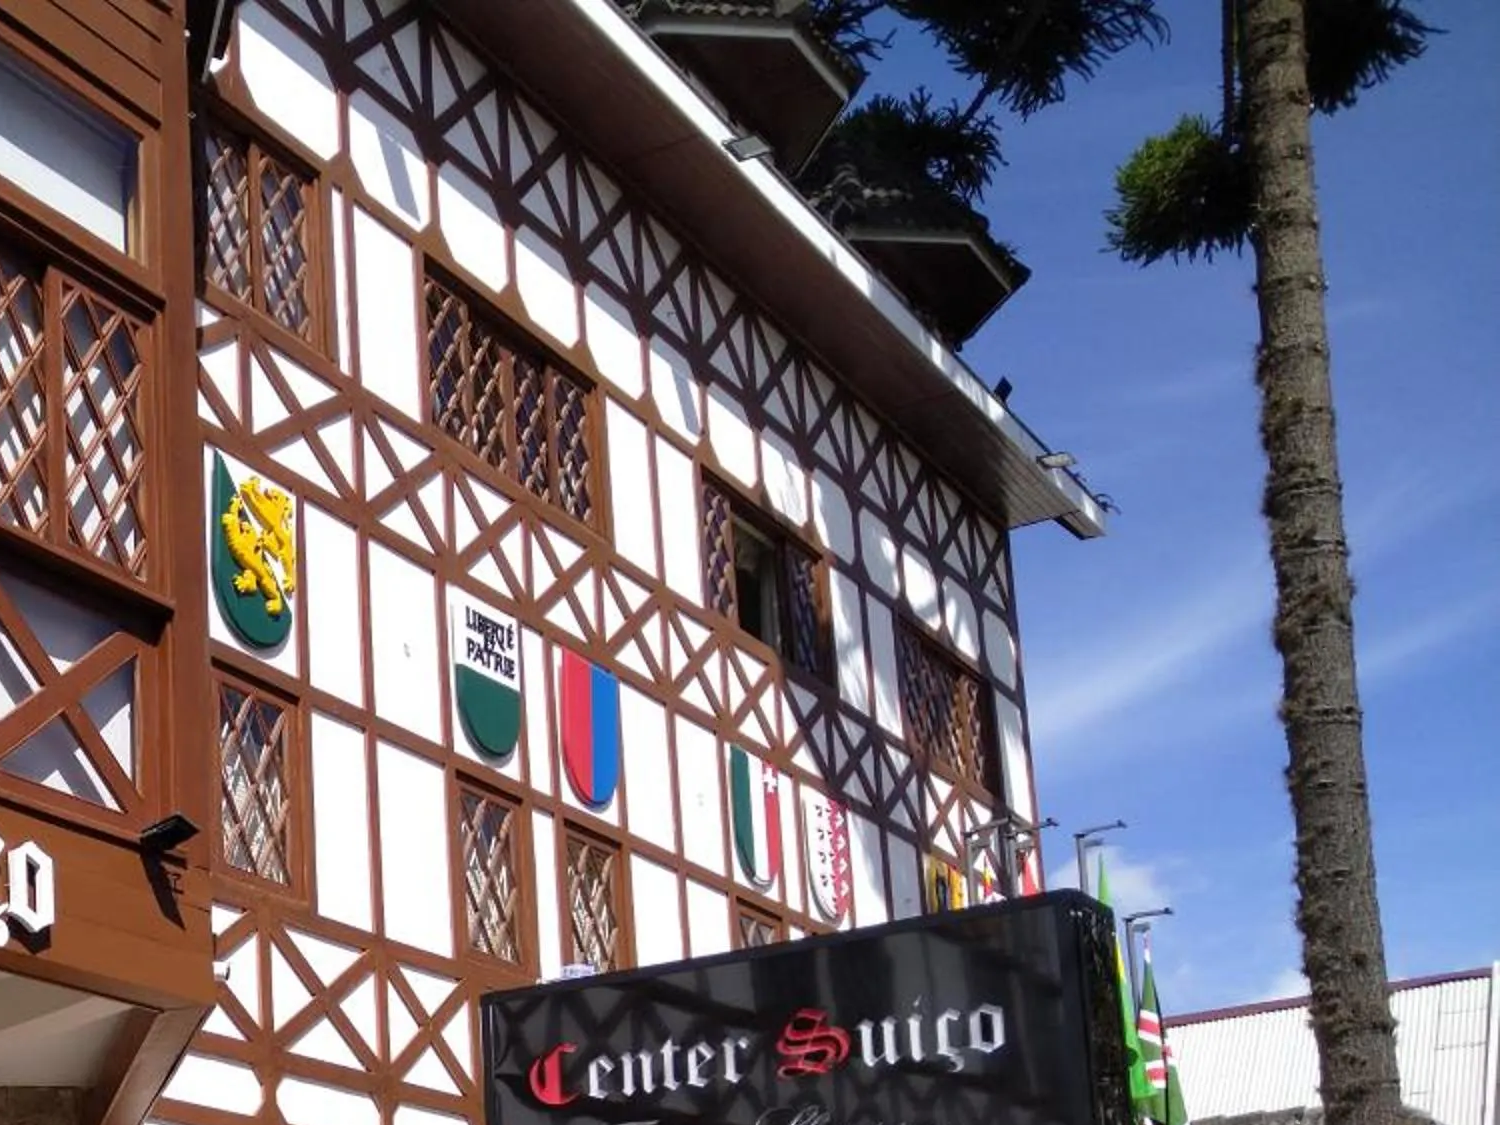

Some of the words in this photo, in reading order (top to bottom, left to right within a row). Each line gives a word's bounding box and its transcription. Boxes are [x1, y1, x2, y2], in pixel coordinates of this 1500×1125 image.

[465, 636, 516, 680] PATRIE
[528, 1035, 749, 1105] Center
[775, 995, 1006, 1079] Suiço
